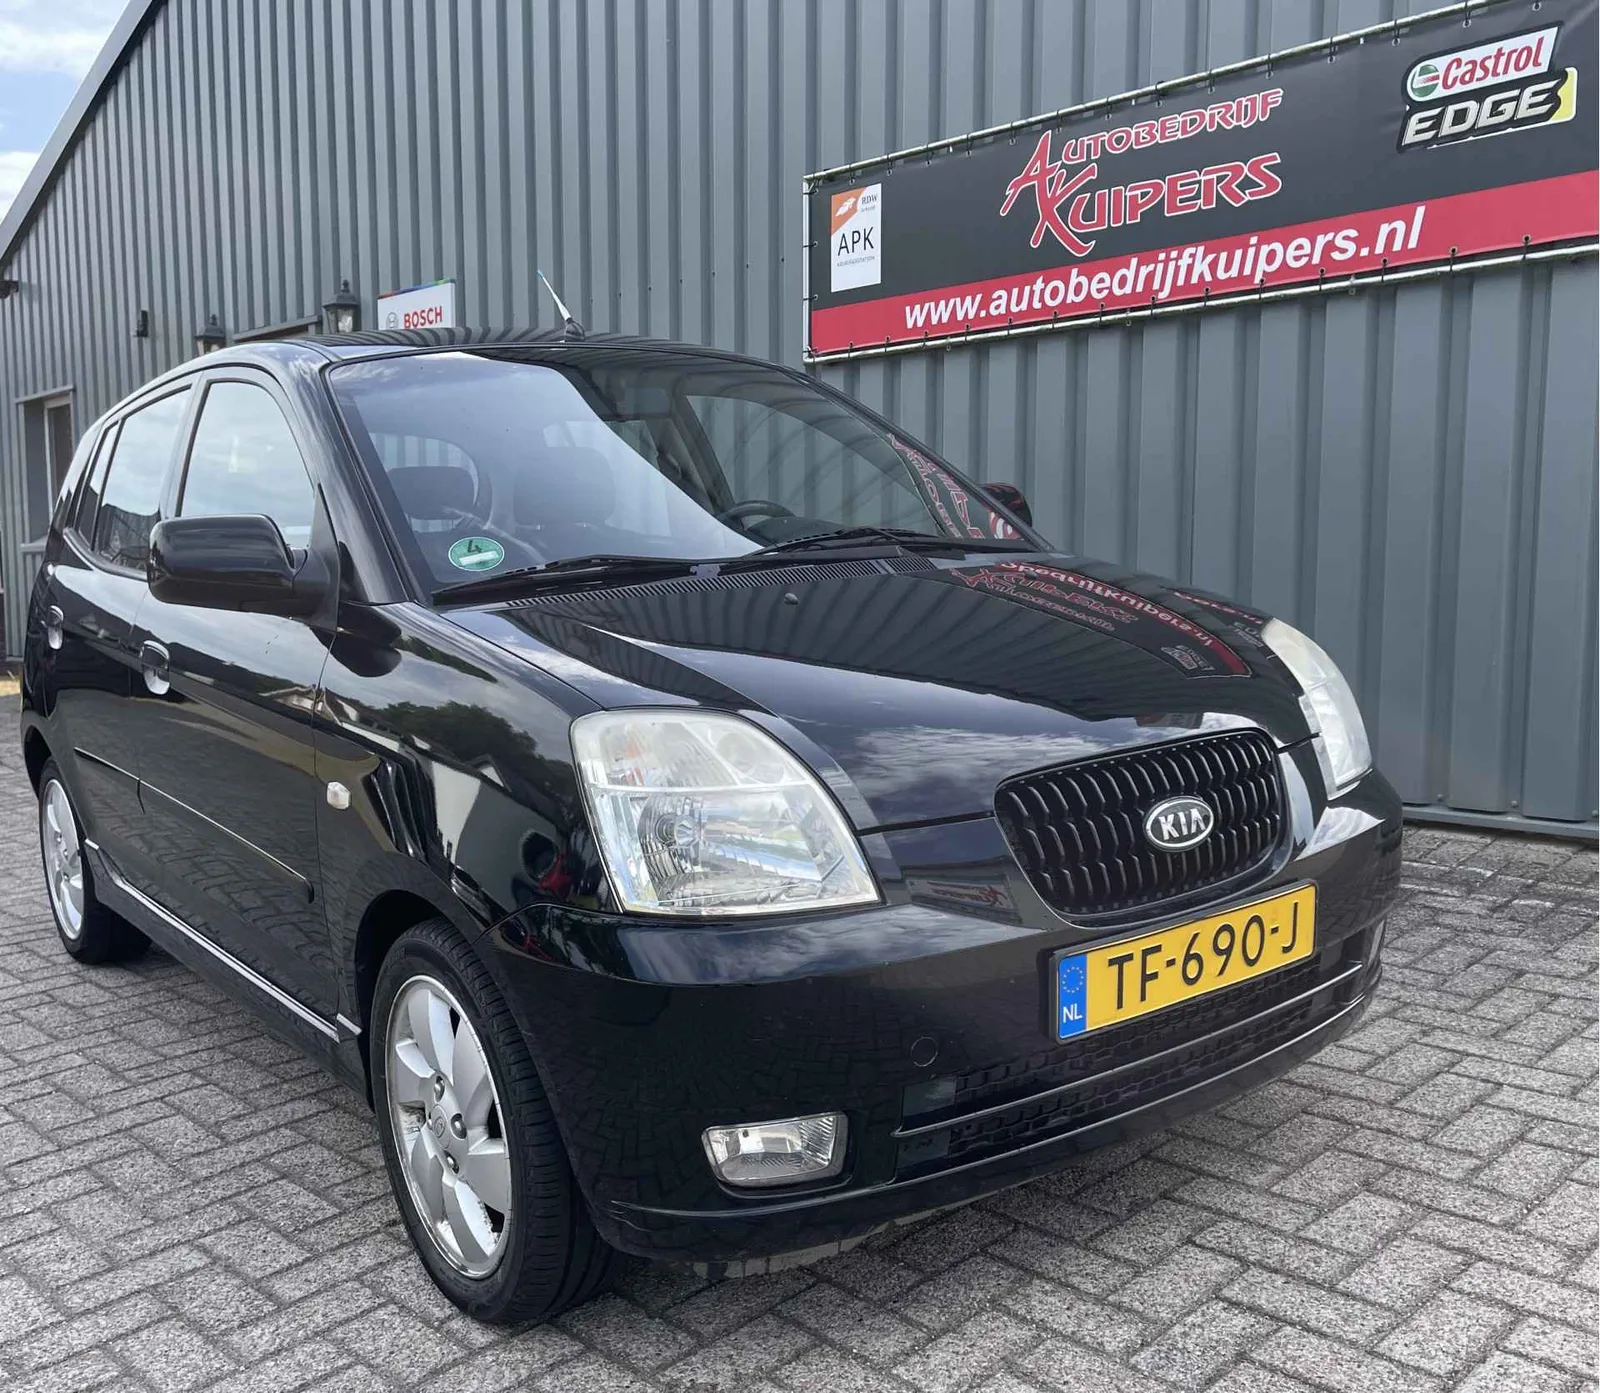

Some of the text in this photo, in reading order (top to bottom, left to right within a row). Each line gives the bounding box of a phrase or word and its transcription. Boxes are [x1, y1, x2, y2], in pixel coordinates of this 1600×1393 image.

[1441, 36, 1545, 90] Castrol
[1401, 79, 1562, 147] EDGE
[1000, 88, 1284, 216] AUTOBEDRIJF
[1029, 152, 1282, 257] KUIPERS
[837, 226, 875, 257] APK
[904, 206, 1427, 329] www.autobedrijfkuipers.nl
[403, 305, 443, 330] BOSCH
[467, 539, 482, 553] 4
[1157, 808, 1206, 841] KIA
[1107, 900, 1300, 1010] TF-690-J
[1062, 1002, 1083, 1024] NL
